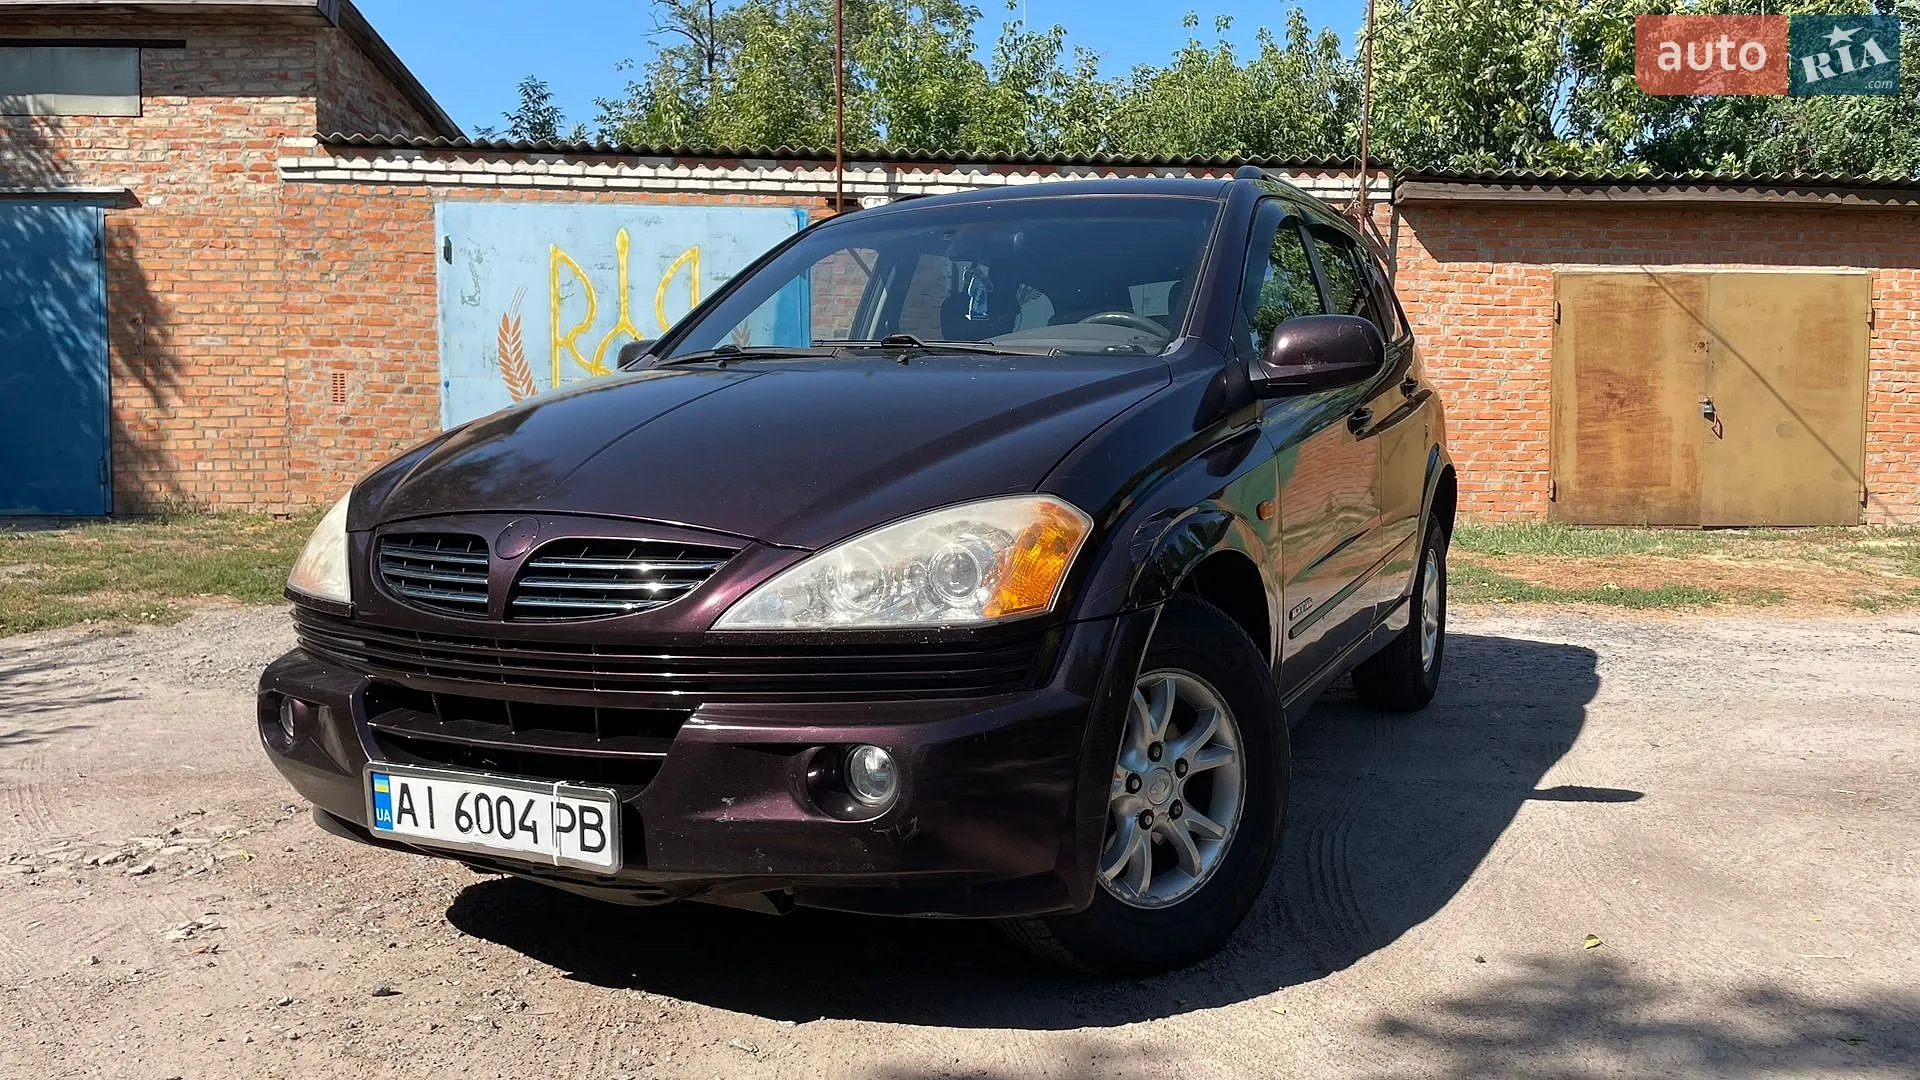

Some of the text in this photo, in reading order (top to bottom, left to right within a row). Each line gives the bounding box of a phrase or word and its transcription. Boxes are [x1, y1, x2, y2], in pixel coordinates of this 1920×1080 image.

[376, 807, 392, 823] UA
[396, 782, 606, 853] AI 6004 PB
